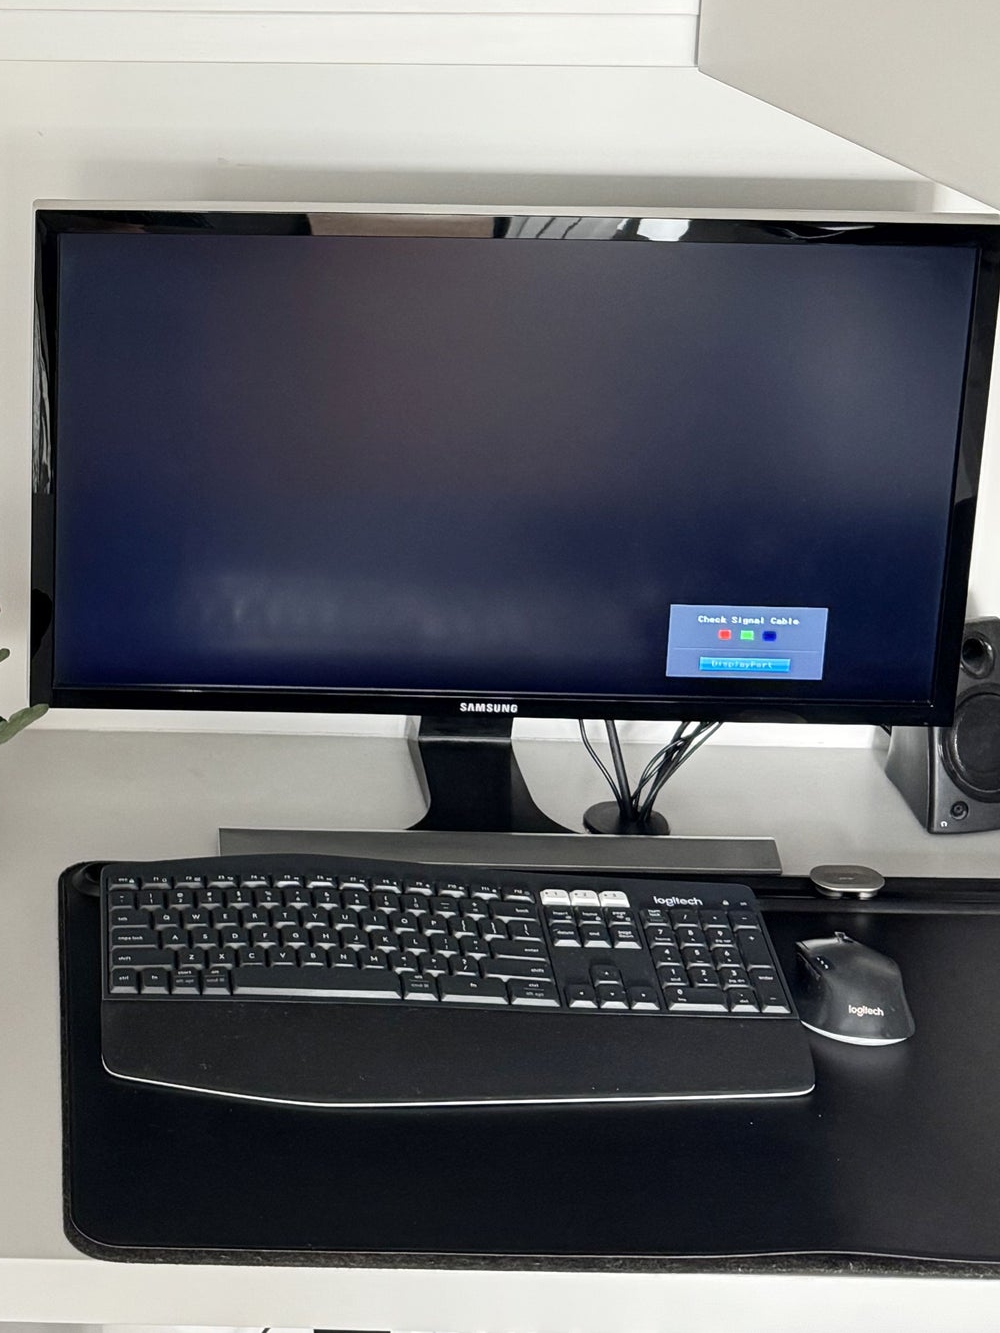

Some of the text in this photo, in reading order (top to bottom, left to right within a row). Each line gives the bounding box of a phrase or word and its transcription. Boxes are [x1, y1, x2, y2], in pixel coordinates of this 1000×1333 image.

[697, 615, 800, 625] Check Signal Cable
[711, 659, 772, 669] DisplayPort
[459, 702, 518, 713] SAMSUNG
[653, 896, 703, 906] logitech
[848, 1004, 885, 1017] logitech
